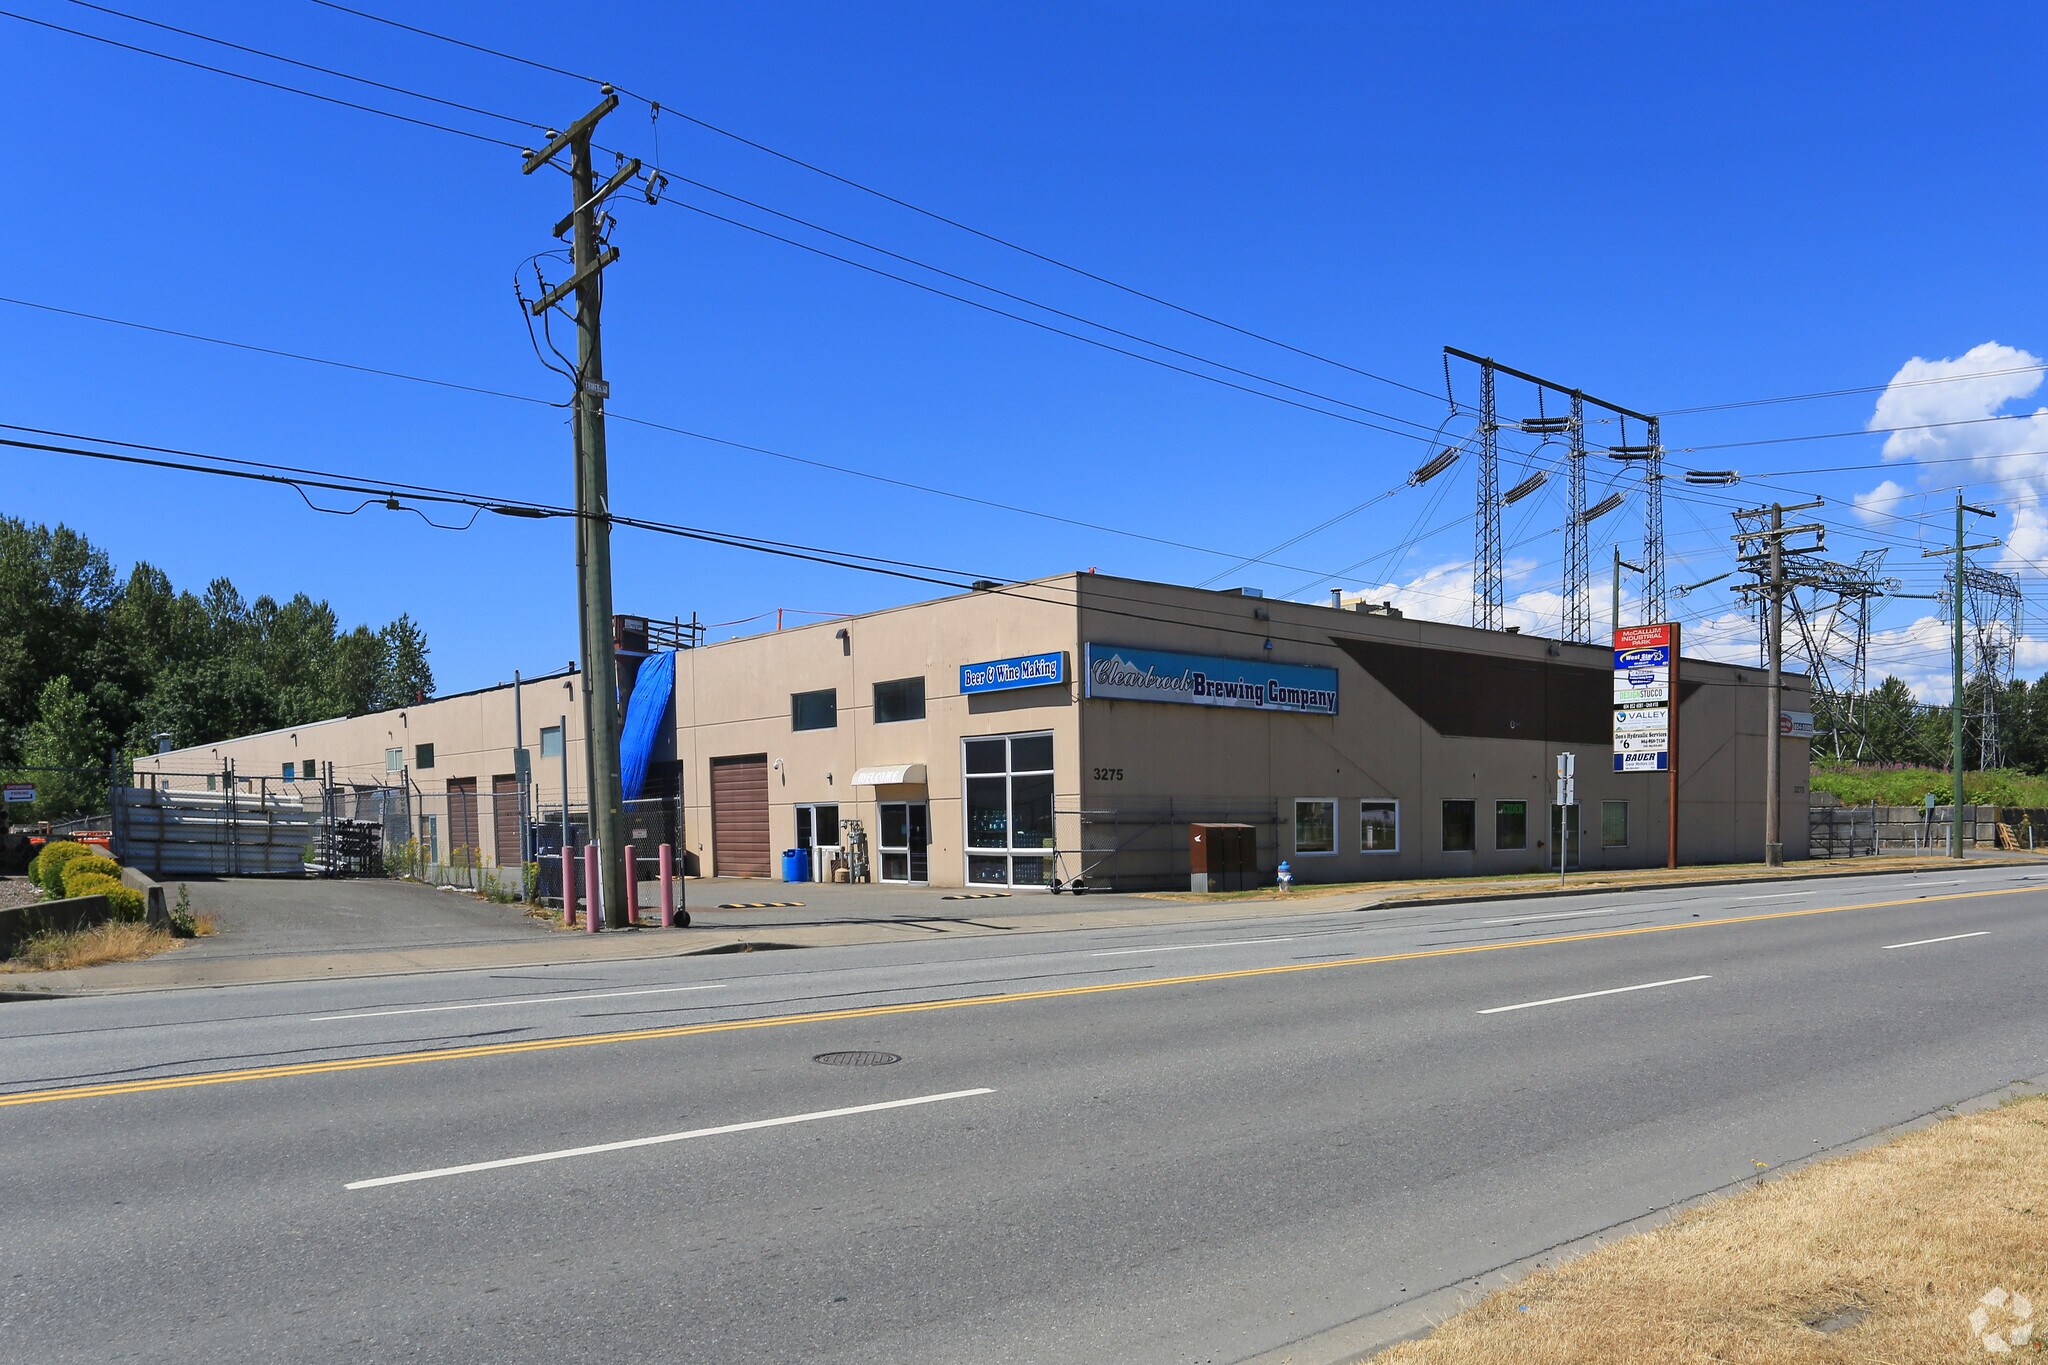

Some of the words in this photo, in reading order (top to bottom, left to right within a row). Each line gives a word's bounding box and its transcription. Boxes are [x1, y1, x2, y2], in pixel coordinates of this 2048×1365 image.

[1621, 633, 1662, 642] INDUSTRIAL
[1622, 628, 1662, 636] McCALLUM
[964, 669, 985, 686] Beer
[986, 665, 994, 683] &
[996, 664, 1020, 682] Wine
[1021, 658, 1057, 679] Making
[1092, 658, 1192, 692] Clearbrook
[1191, 671, 1265, 706] Brewing
[1268, 678, 1336, 713] Company
[1625, 753, 1656, 762] BAUER
[857, 770, 900, 783] WELCOME
[1093, 768, 1124, 781] 3275
[1503, 804, 1524, 814] CIDER
